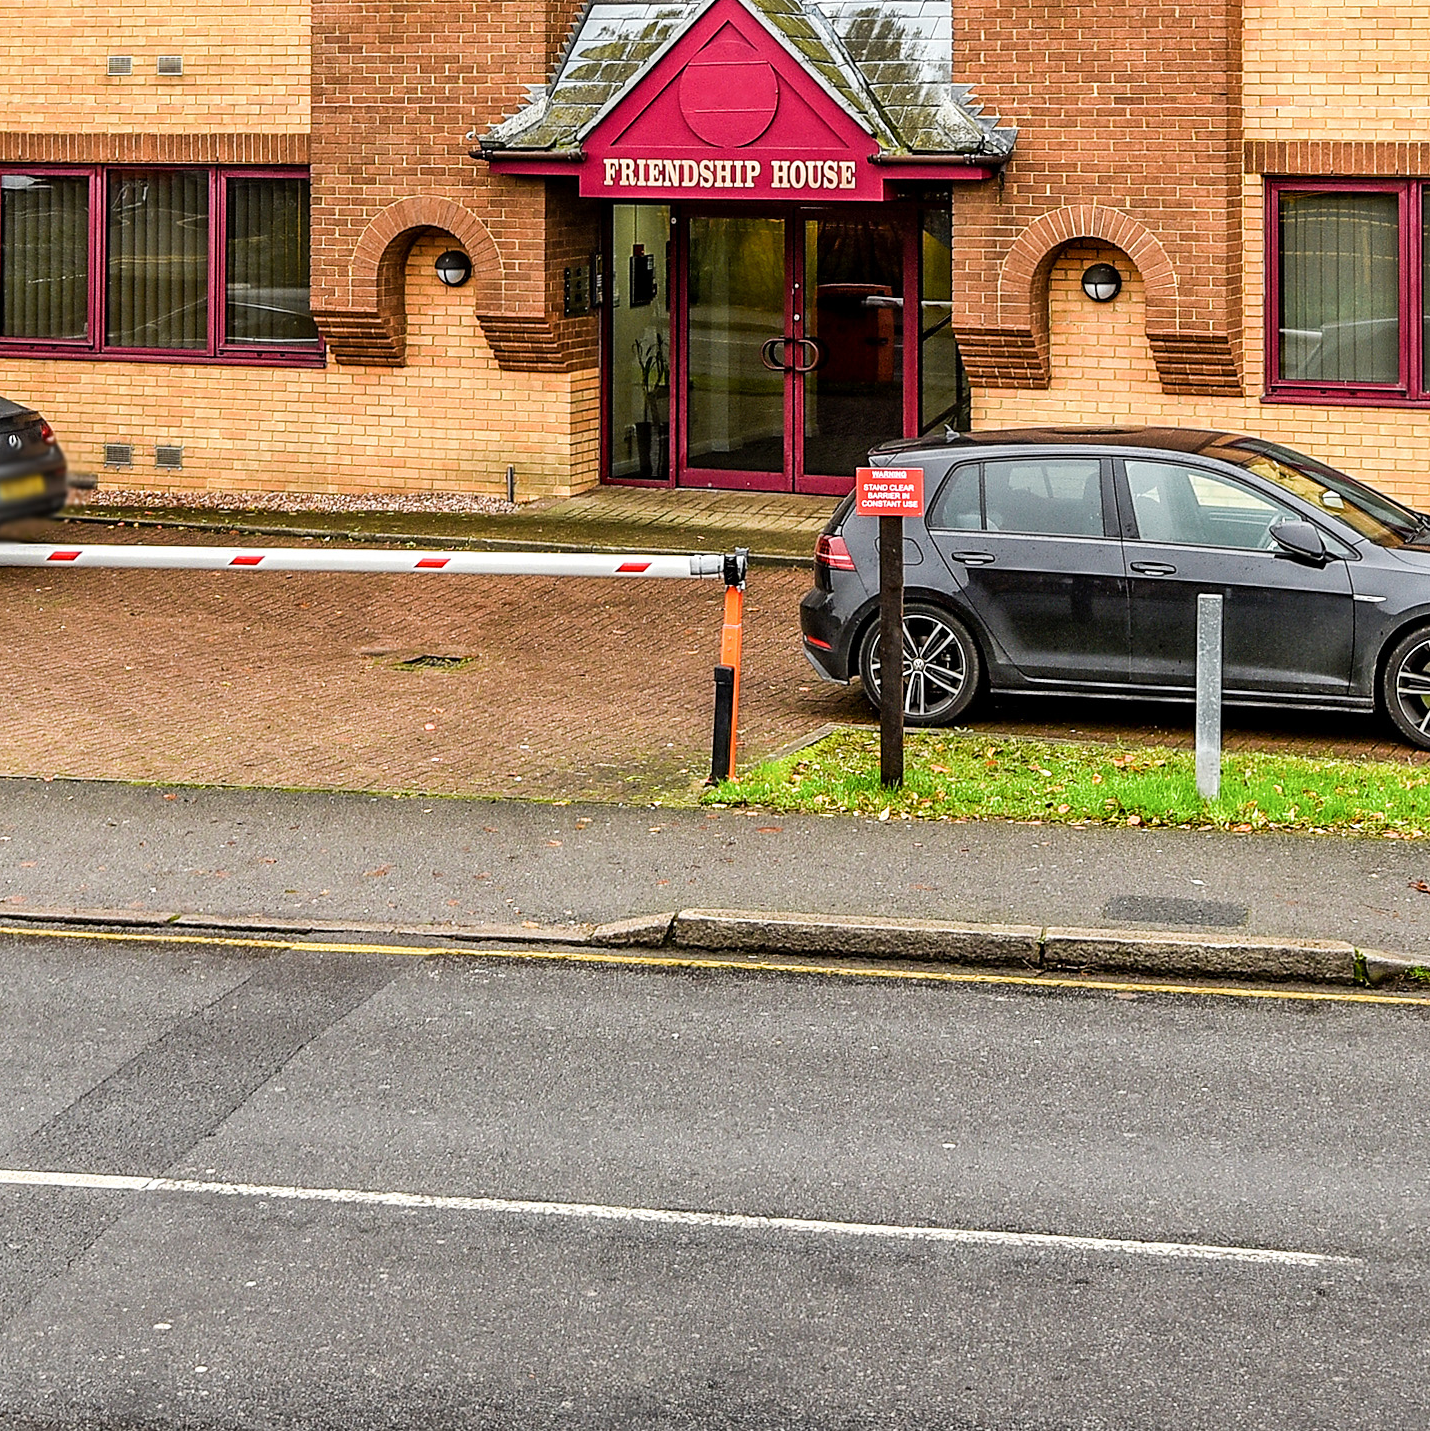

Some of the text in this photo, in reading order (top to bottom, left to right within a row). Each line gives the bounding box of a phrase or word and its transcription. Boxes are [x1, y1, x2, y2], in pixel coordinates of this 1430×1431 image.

[603, 158, 856, 189] FRIENDSHIP HOUSE
[872, 471, 907, 479] WARNING
